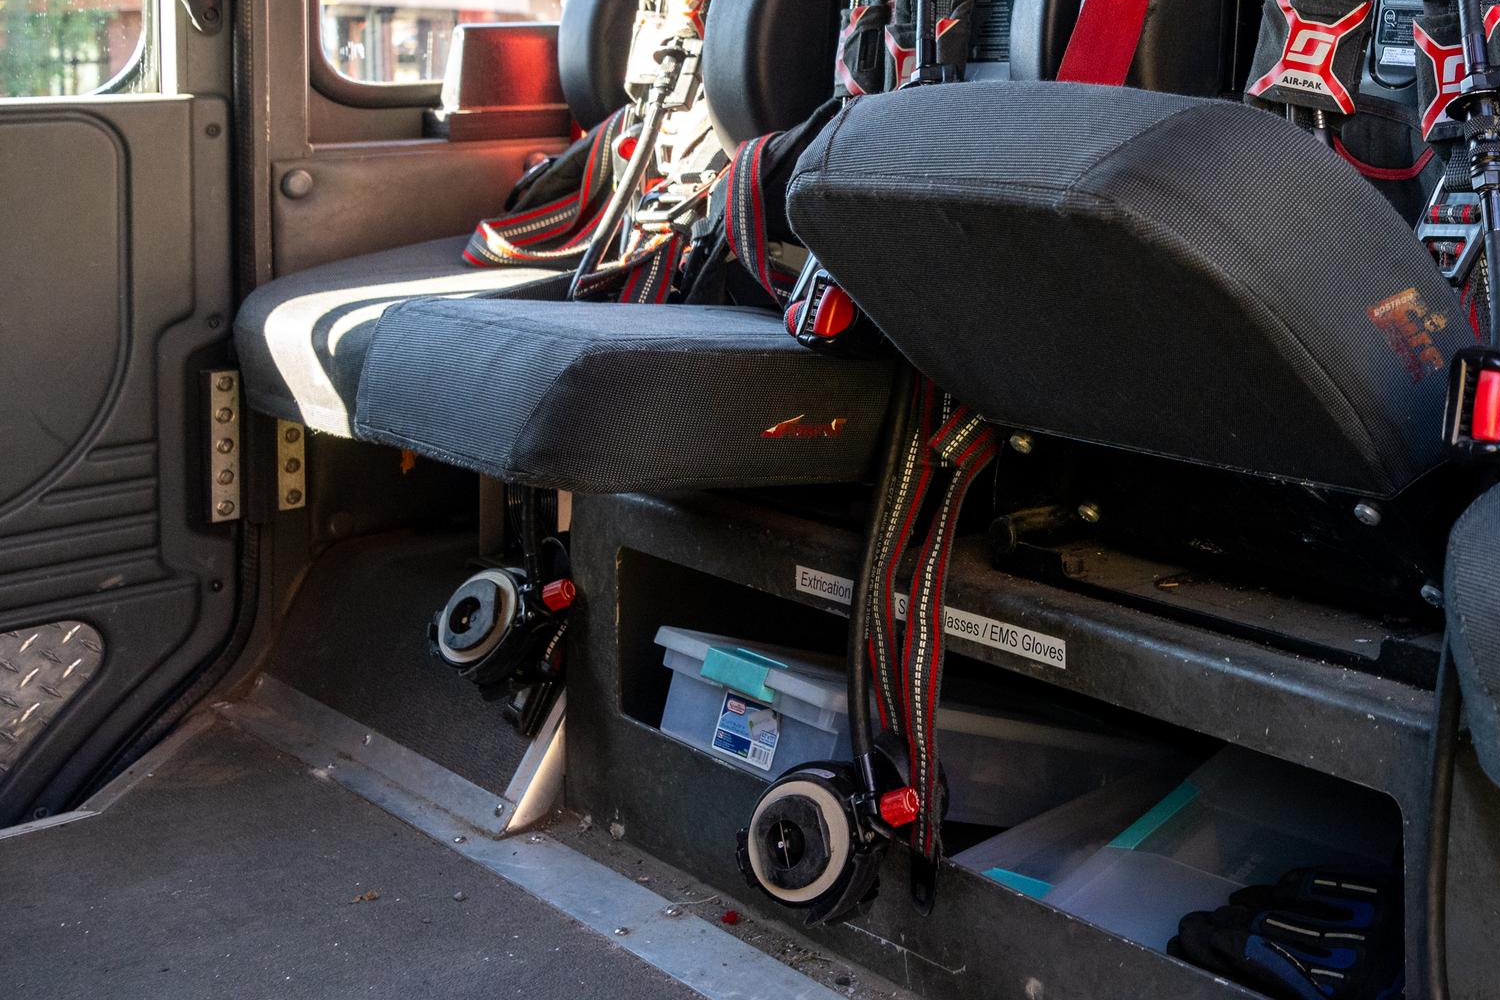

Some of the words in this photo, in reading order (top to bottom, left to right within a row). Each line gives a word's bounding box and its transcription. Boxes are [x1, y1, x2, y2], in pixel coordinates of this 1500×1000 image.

[1282, 76, 1322, 90] AIR-PAK
[801, 571, 851, 600] Extrication
[990, 624, 1019, 648] EMS
[1021, 633, 1065, 662] Gloves
